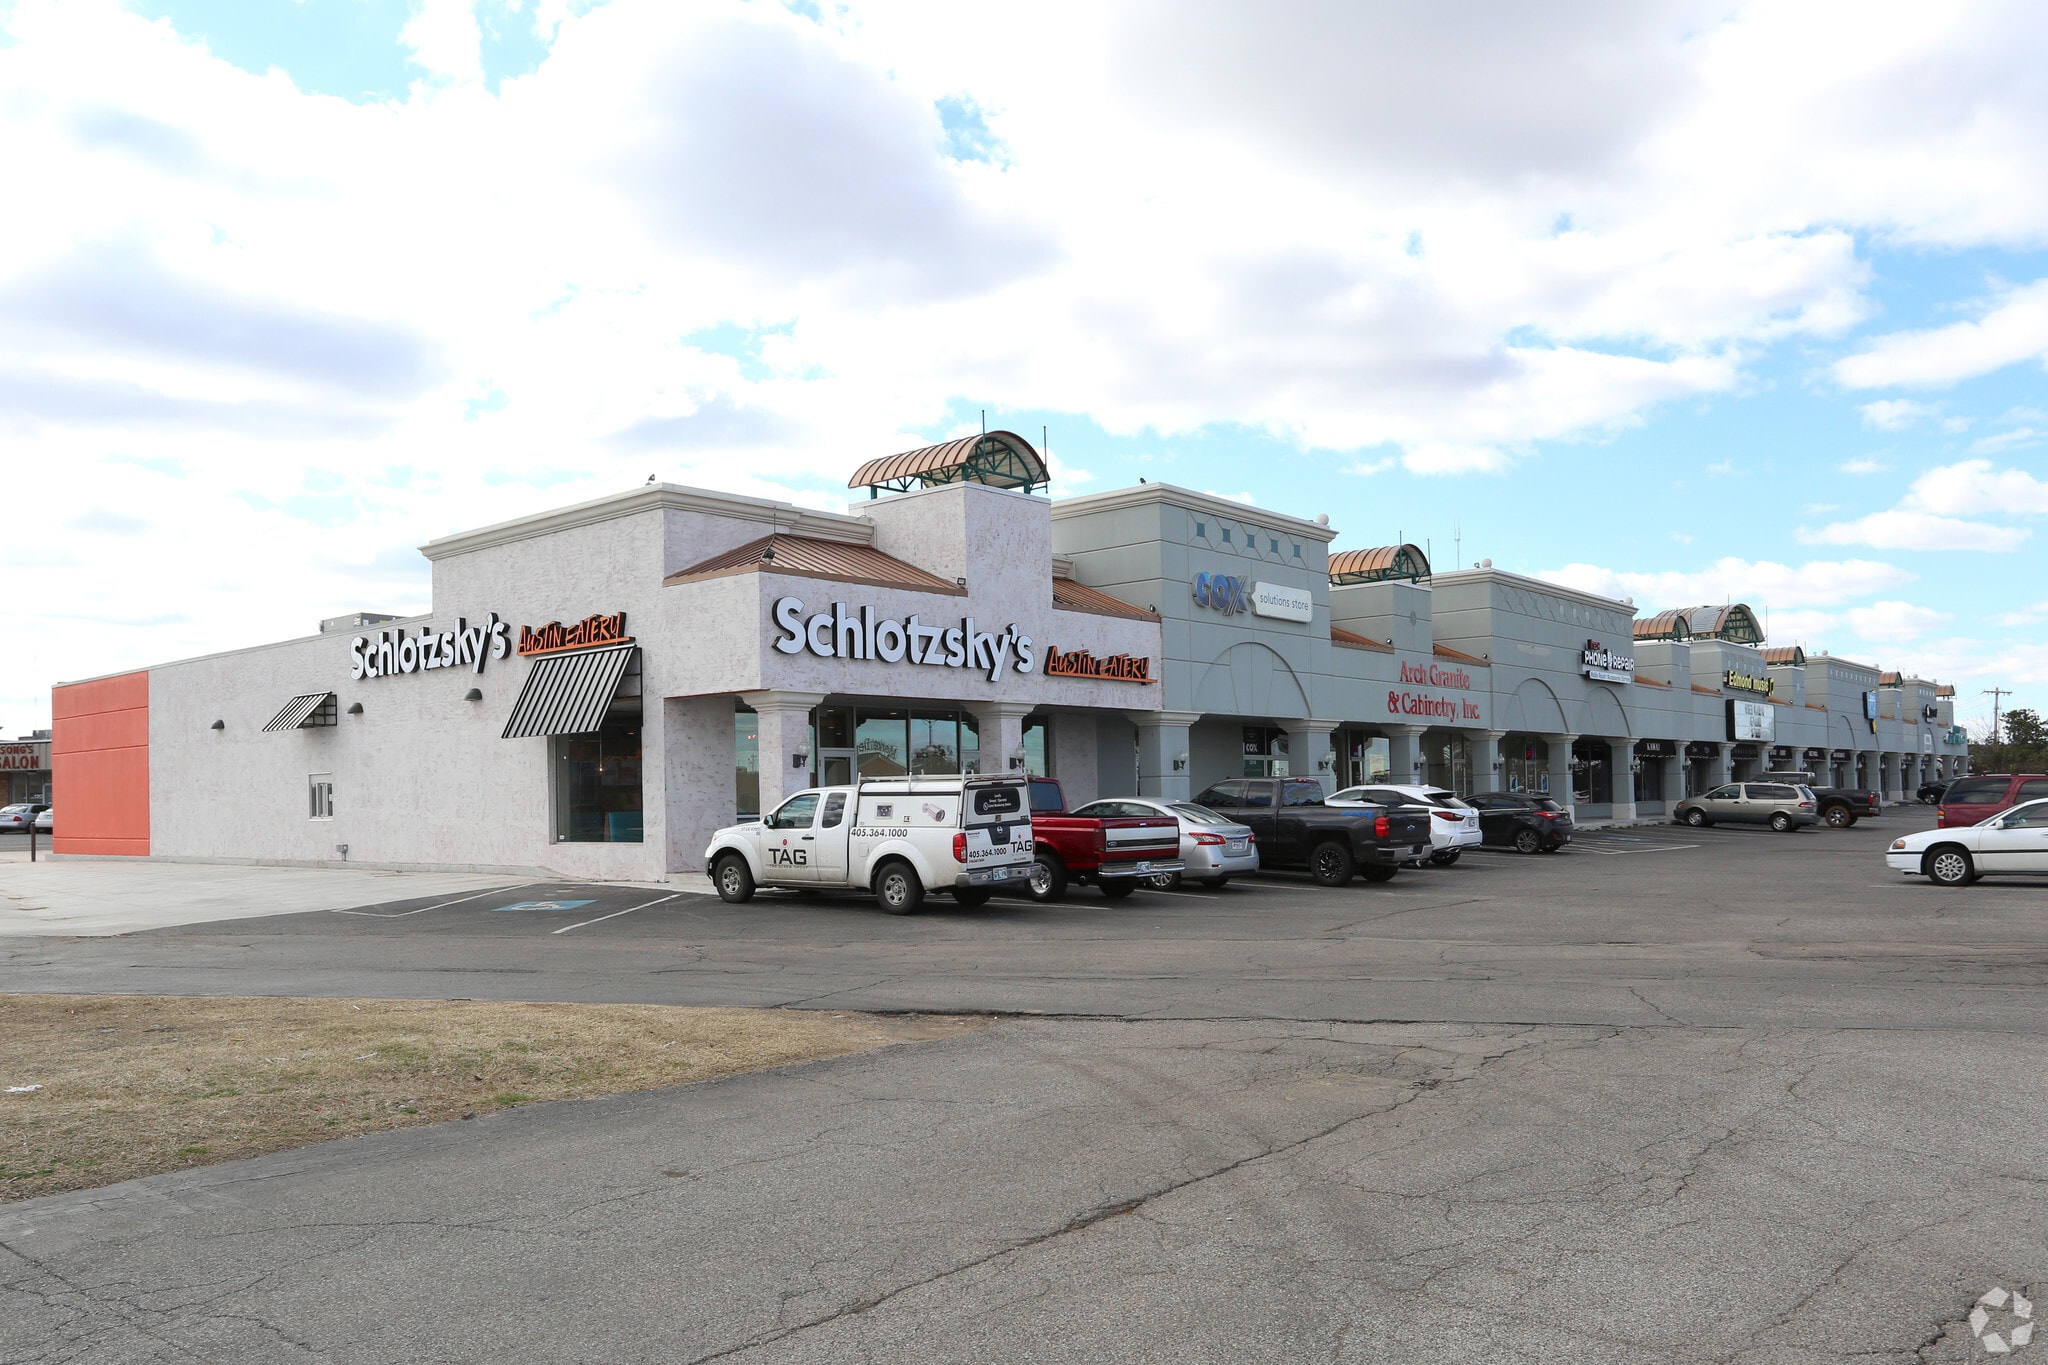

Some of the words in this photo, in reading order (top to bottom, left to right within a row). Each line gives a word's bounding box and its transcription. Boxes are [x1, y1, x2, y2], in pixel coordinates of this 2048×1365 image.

[1193, 571, 1248, 616] COX
[1260, 593, 1290, 608] solutions
[1291, 599, 1309, 610] store
[564, 612, 622, 646] EATERY
[350, 612, 508, 680] Schlotzsky's
[773, 597, 1035, 682] Schlotzsky's
[1099, 652, 1150, 680] EATERY
[1400, 660, 1428, 684] Arch
[1429, 663, 1471, 689] Granite
[1728, 670, 1752, 689] Edmond
[1387, 690, 1400, 714] &
[1402, 692, 1459, 723] Cabinetry,
[1463, 698, 1481, 719] Inc.
[0, 745, 34, 754] SONG'S
[0, 756, 39, 769] ALON
[851, 829, 908, 837] 405.364.1000
[969, 848, 1007, 858] 405.364.1000
[1010, 840, 1033, 853] TAG
[768, 848, 807, 865] TAG
